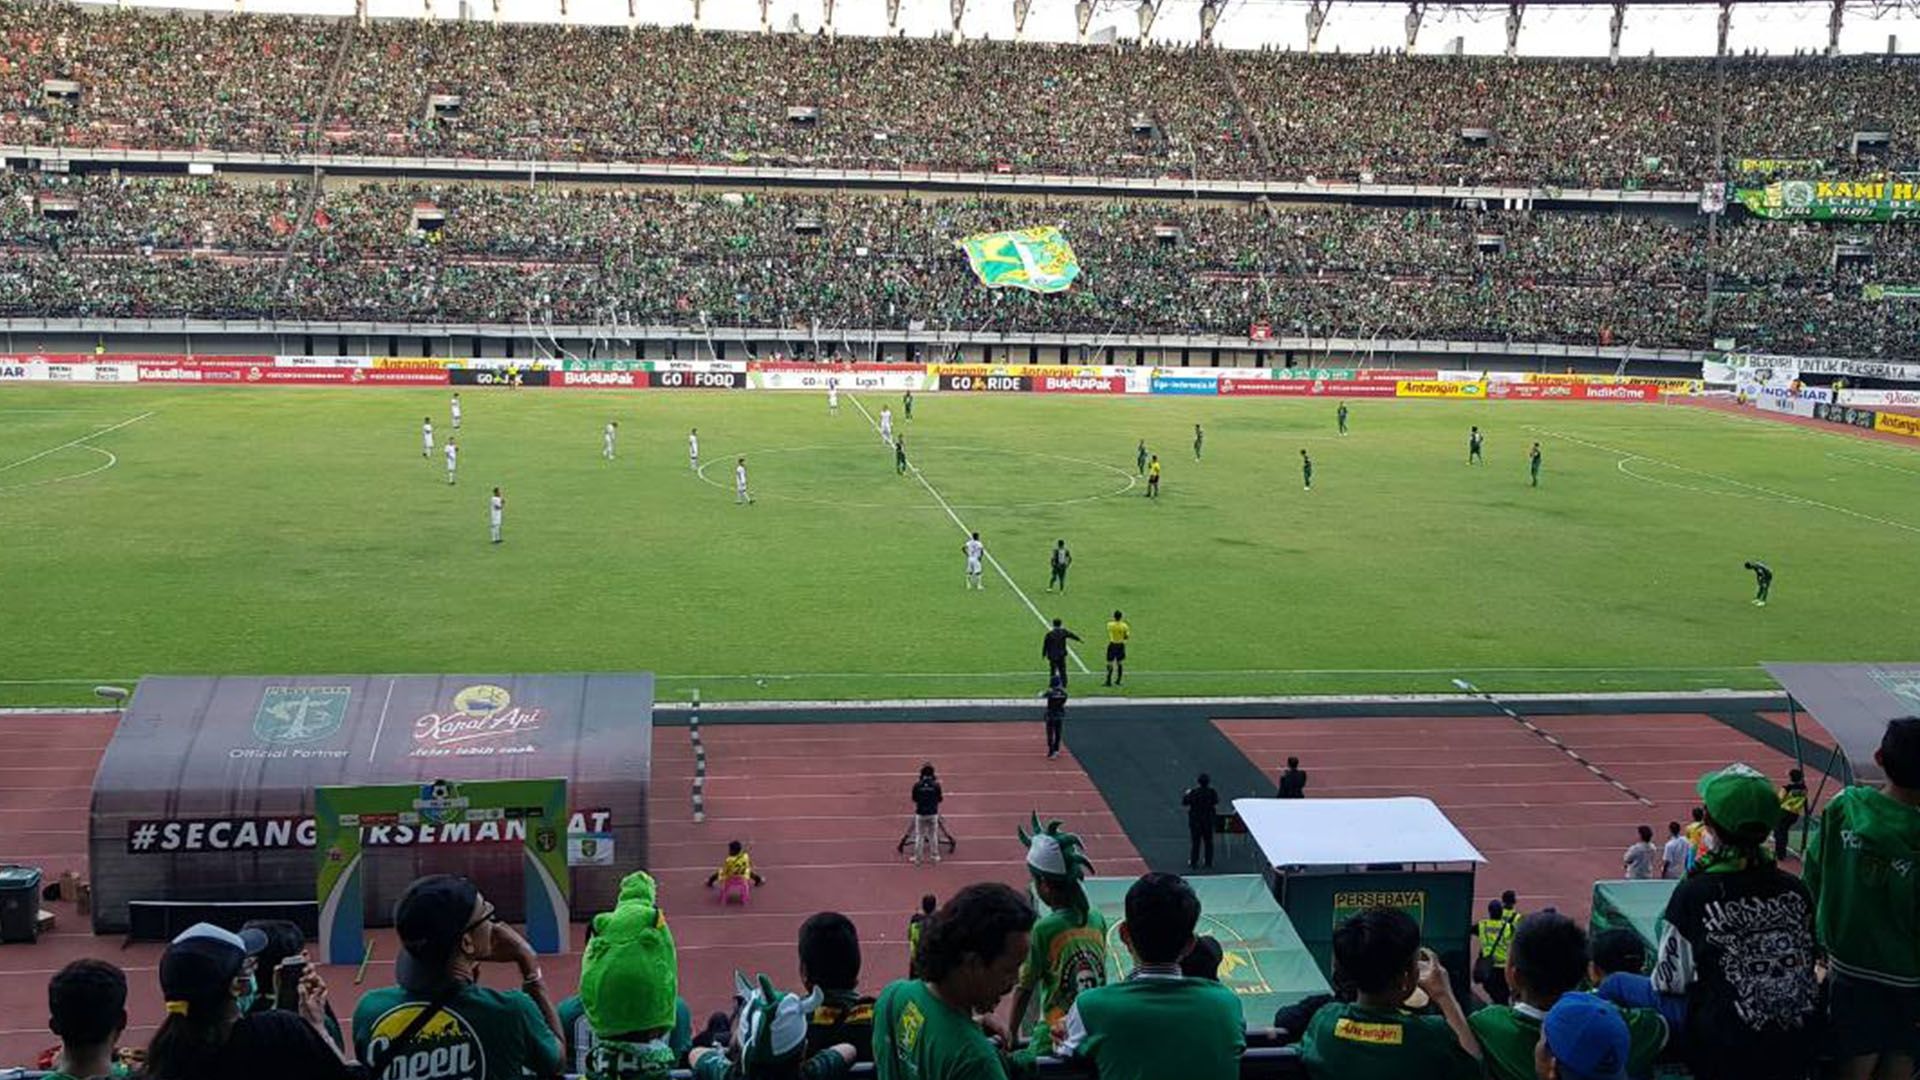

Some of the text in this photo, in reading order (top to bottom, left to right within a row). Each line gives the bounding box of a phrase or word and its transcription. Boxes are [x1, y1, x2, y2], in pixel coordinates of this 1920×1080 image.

[1817, 182, 1883, 198] KAMI
[1799, 358, 1837, 372] UNTUK
[1841, 360, 1906, 378] PERSEBAYA
[661, 373, 734, 386] GO FOOD
[951, 377, 1021, 390] GO RIDE
[1404, 383, 1459, 393] Antangin
[414, 706, 540, 740] Kapal Api
[229, 747, 349, 758] Official Partner
[1336, 892, 1421, 906] PERSEBAYA
